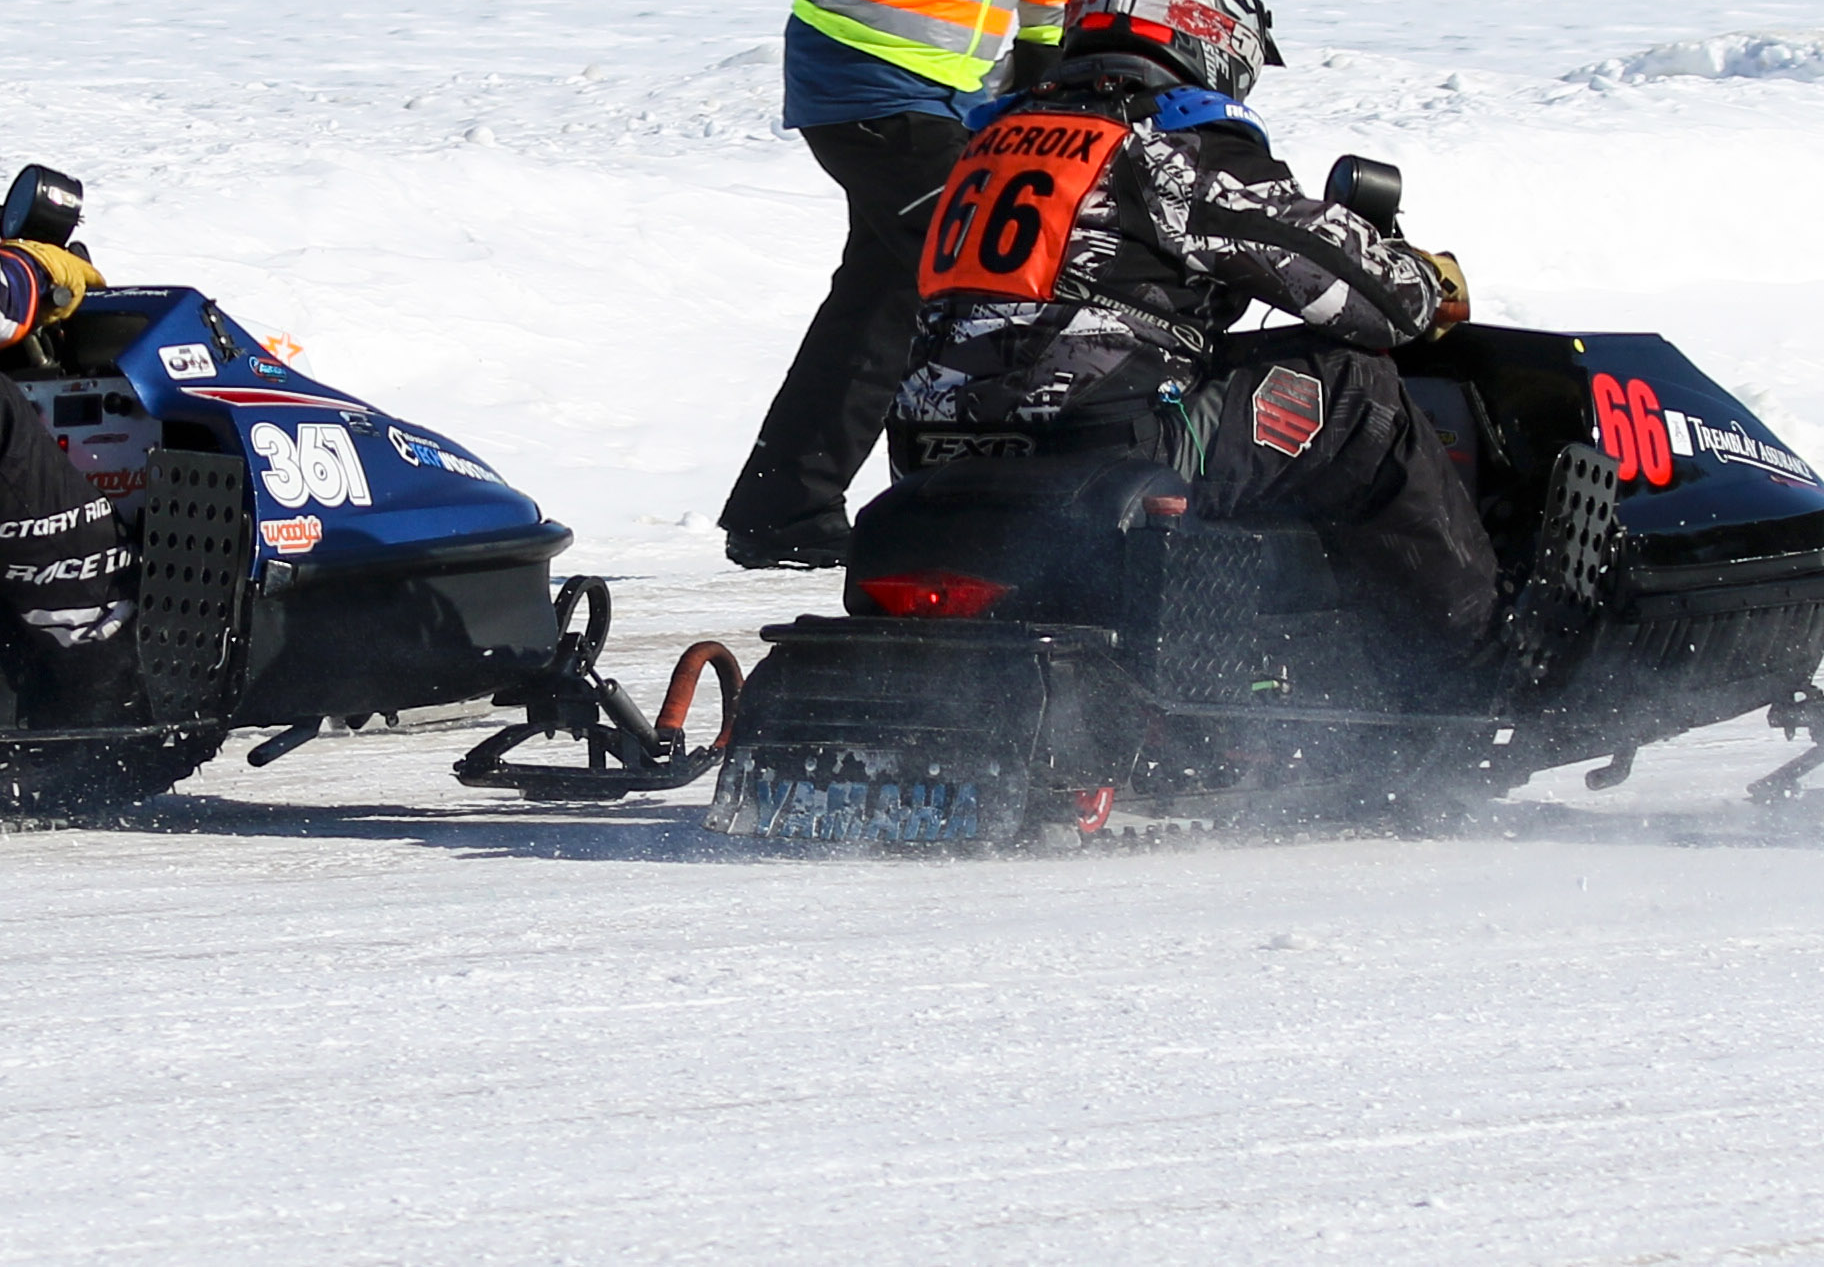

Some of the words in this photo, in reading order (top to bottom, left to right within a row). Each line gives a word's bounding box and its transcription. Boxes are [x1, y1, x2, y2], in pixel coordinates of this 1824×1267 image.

[962, 125, 1104, 164] LACROIX
[932, 168, 1055, 275] 66
[1093, 294, 1172, 332] ANSWER
[917, 434, 1033, 464] FXR
[1592, 373, 1672, 486] 66
[1687, 416, 1757, 464] TREMBLAY
[250, 422, 373, 508] 361
[263, 516, 322, 549] woody's
[5, 552, 102, 586] RACE
[758, 780, 979, 841] YAMAHA
